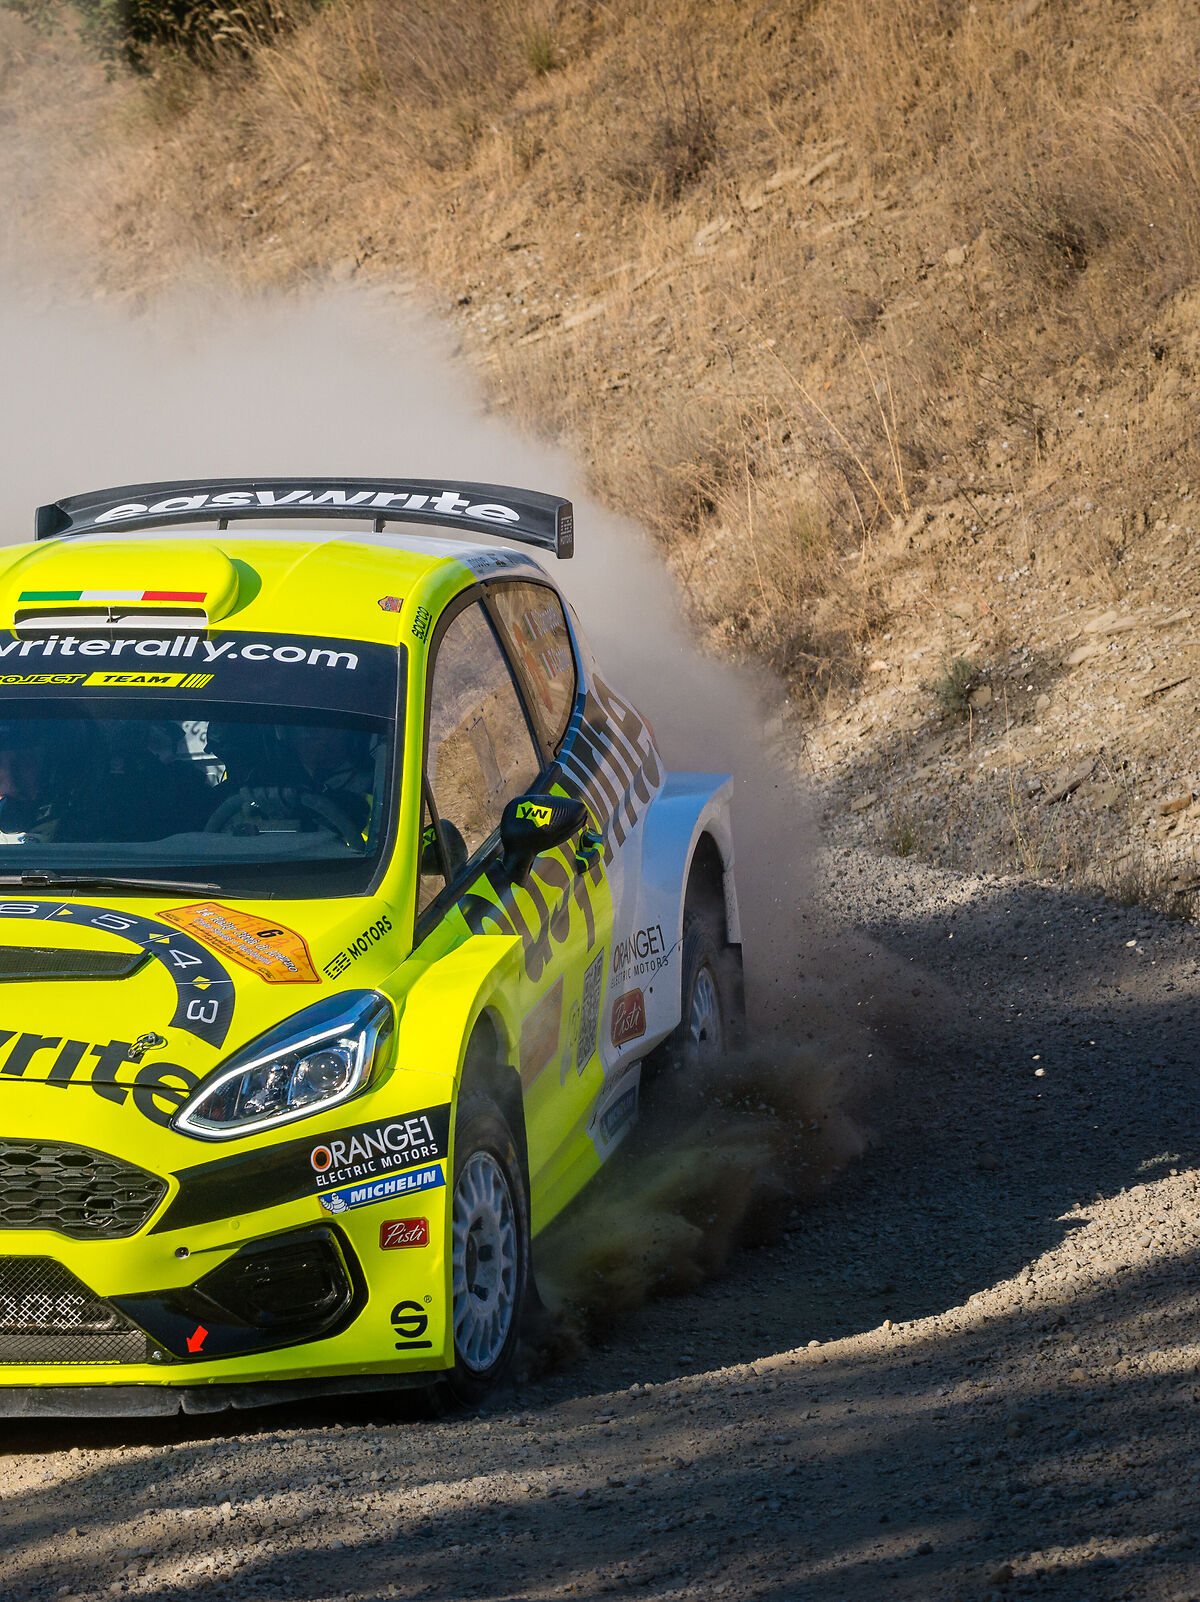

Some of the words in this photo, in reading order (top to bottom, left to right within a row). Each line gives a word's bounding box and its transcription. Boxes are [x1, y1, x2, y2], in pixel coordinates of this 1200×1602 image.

[94, 490, 521, 523] easywrite
[102, 675, 173, 685] TEAM
[256, 929, 284, 938] 6
[347, 915, 392, 960] MOTORS
[613, 924, 666, 974] ORANGE1
[90, 913, 138, 930] 5
[168, 949, 203, 969] 4
[186, 999, 219, 1024] 3
[634, 955, 669, 976] MOTORS
[310, 1115, 434, 1172] ORANGE1
[316, 1161, 376, 1187] ELECTRIC
[381, 1143, 438, 1168] MOTORS
[350, 1170, 436, 1203] MICHELIN
